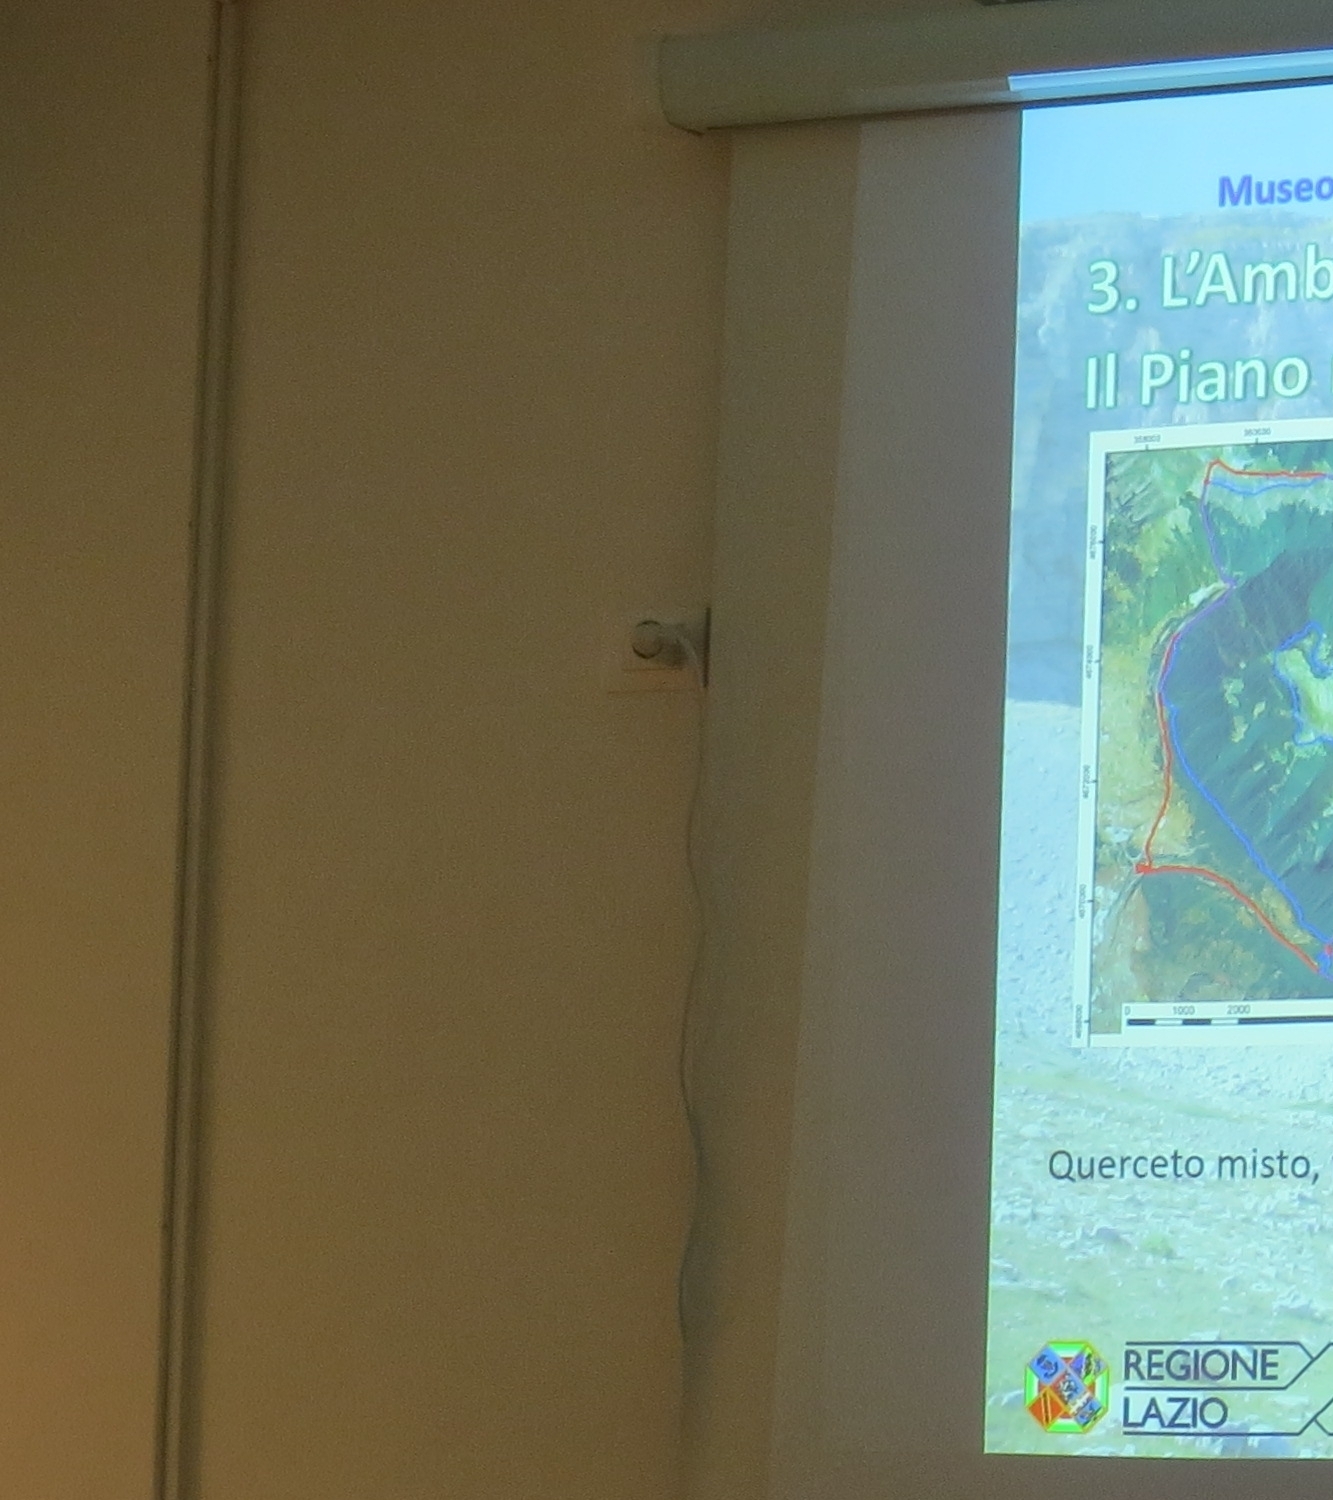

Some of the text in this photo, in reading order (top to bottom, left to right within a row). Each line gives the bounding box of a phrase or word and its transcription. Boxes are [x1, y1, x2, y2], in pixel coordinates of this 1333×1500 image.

[1086, 259, 1140, 316] 3.
[1084, 351, 1119, 411] Il
[1140, 350, 1311, 405] Piano
[1226, 1004, 1252, 1015] 2000
[1048, 1148, 1205, 1183] Querceto
[1217, 1147, 1321, 1185] misto,
[1123, 1348, 1280, 1381] REGIONE
[1122, 1396, 1229, 1430] LAZIO
